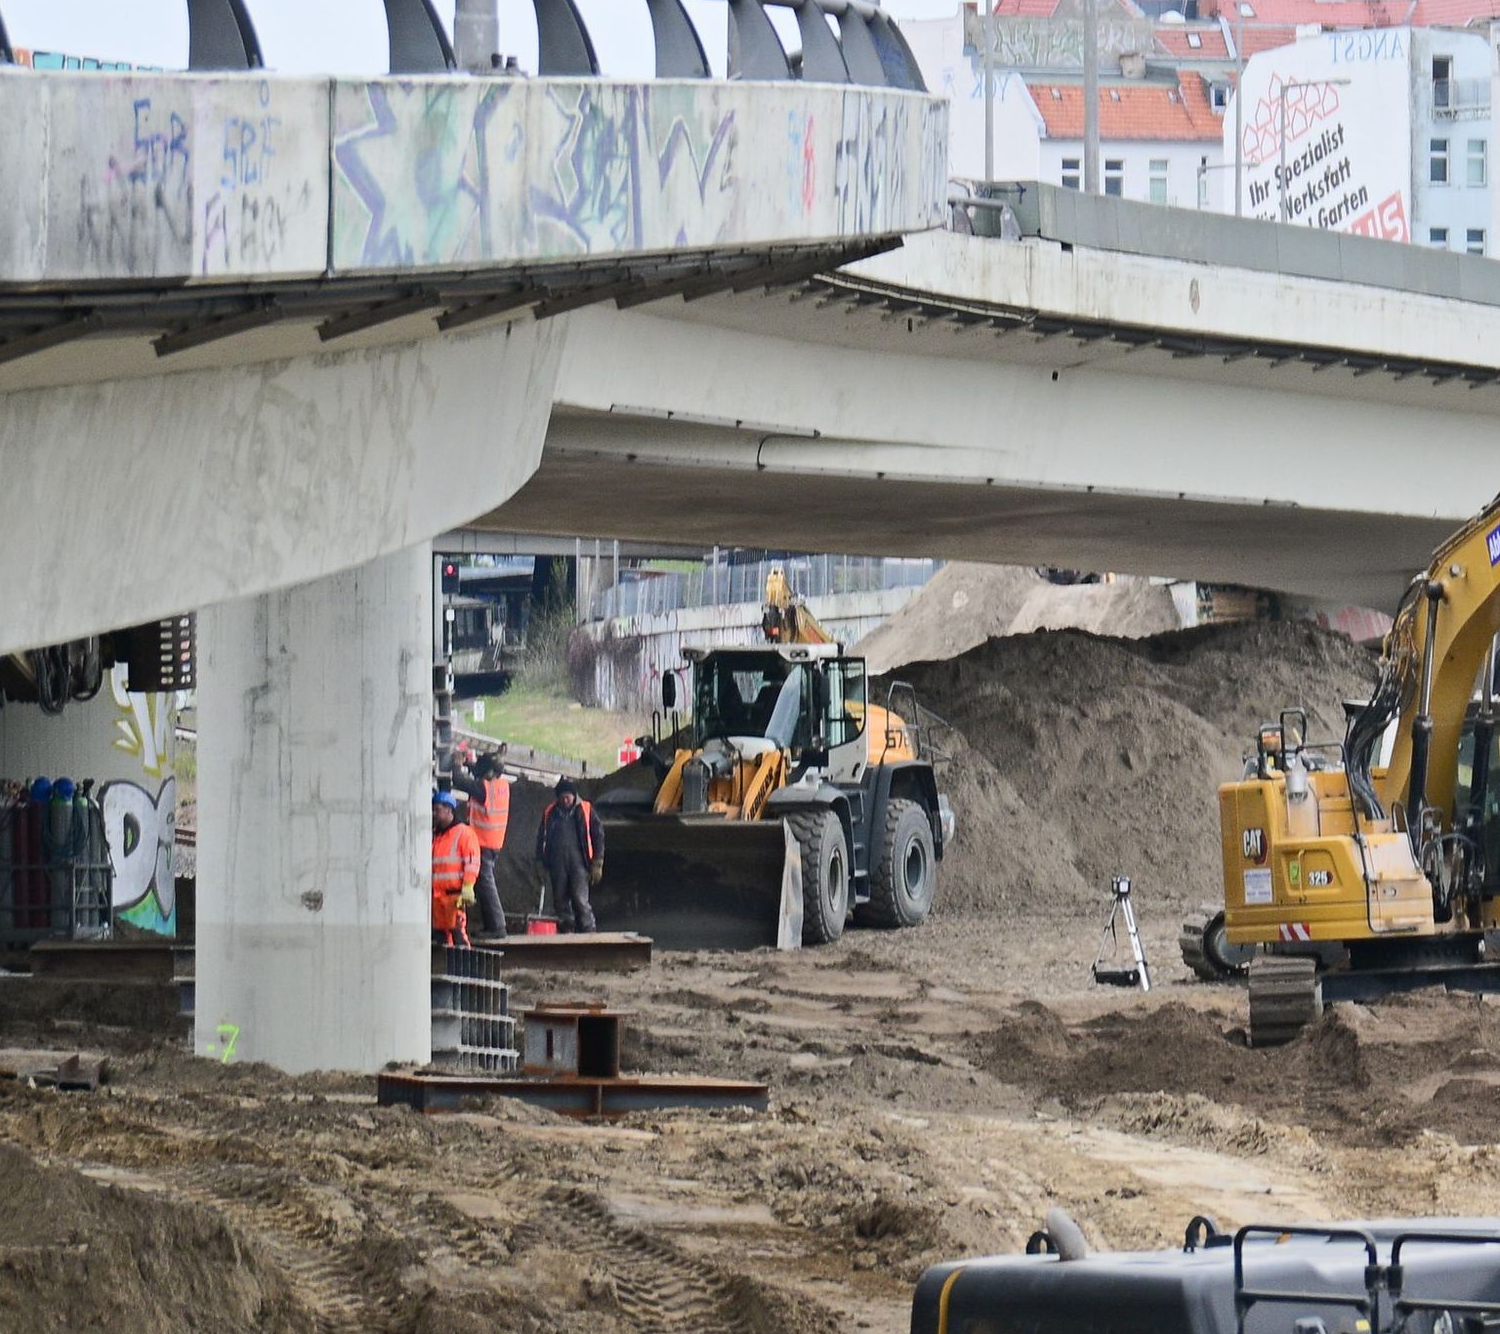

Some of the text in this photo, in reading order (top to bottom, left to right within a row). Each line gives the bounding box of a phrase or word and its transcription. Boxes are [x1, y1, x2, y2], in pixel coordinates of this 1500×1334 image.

[1249, 122, 1344, 208] Ihr Spezialist
[1318, 185, 1368, 227] Garten
[1243, 829, 1262, 859] CAT
